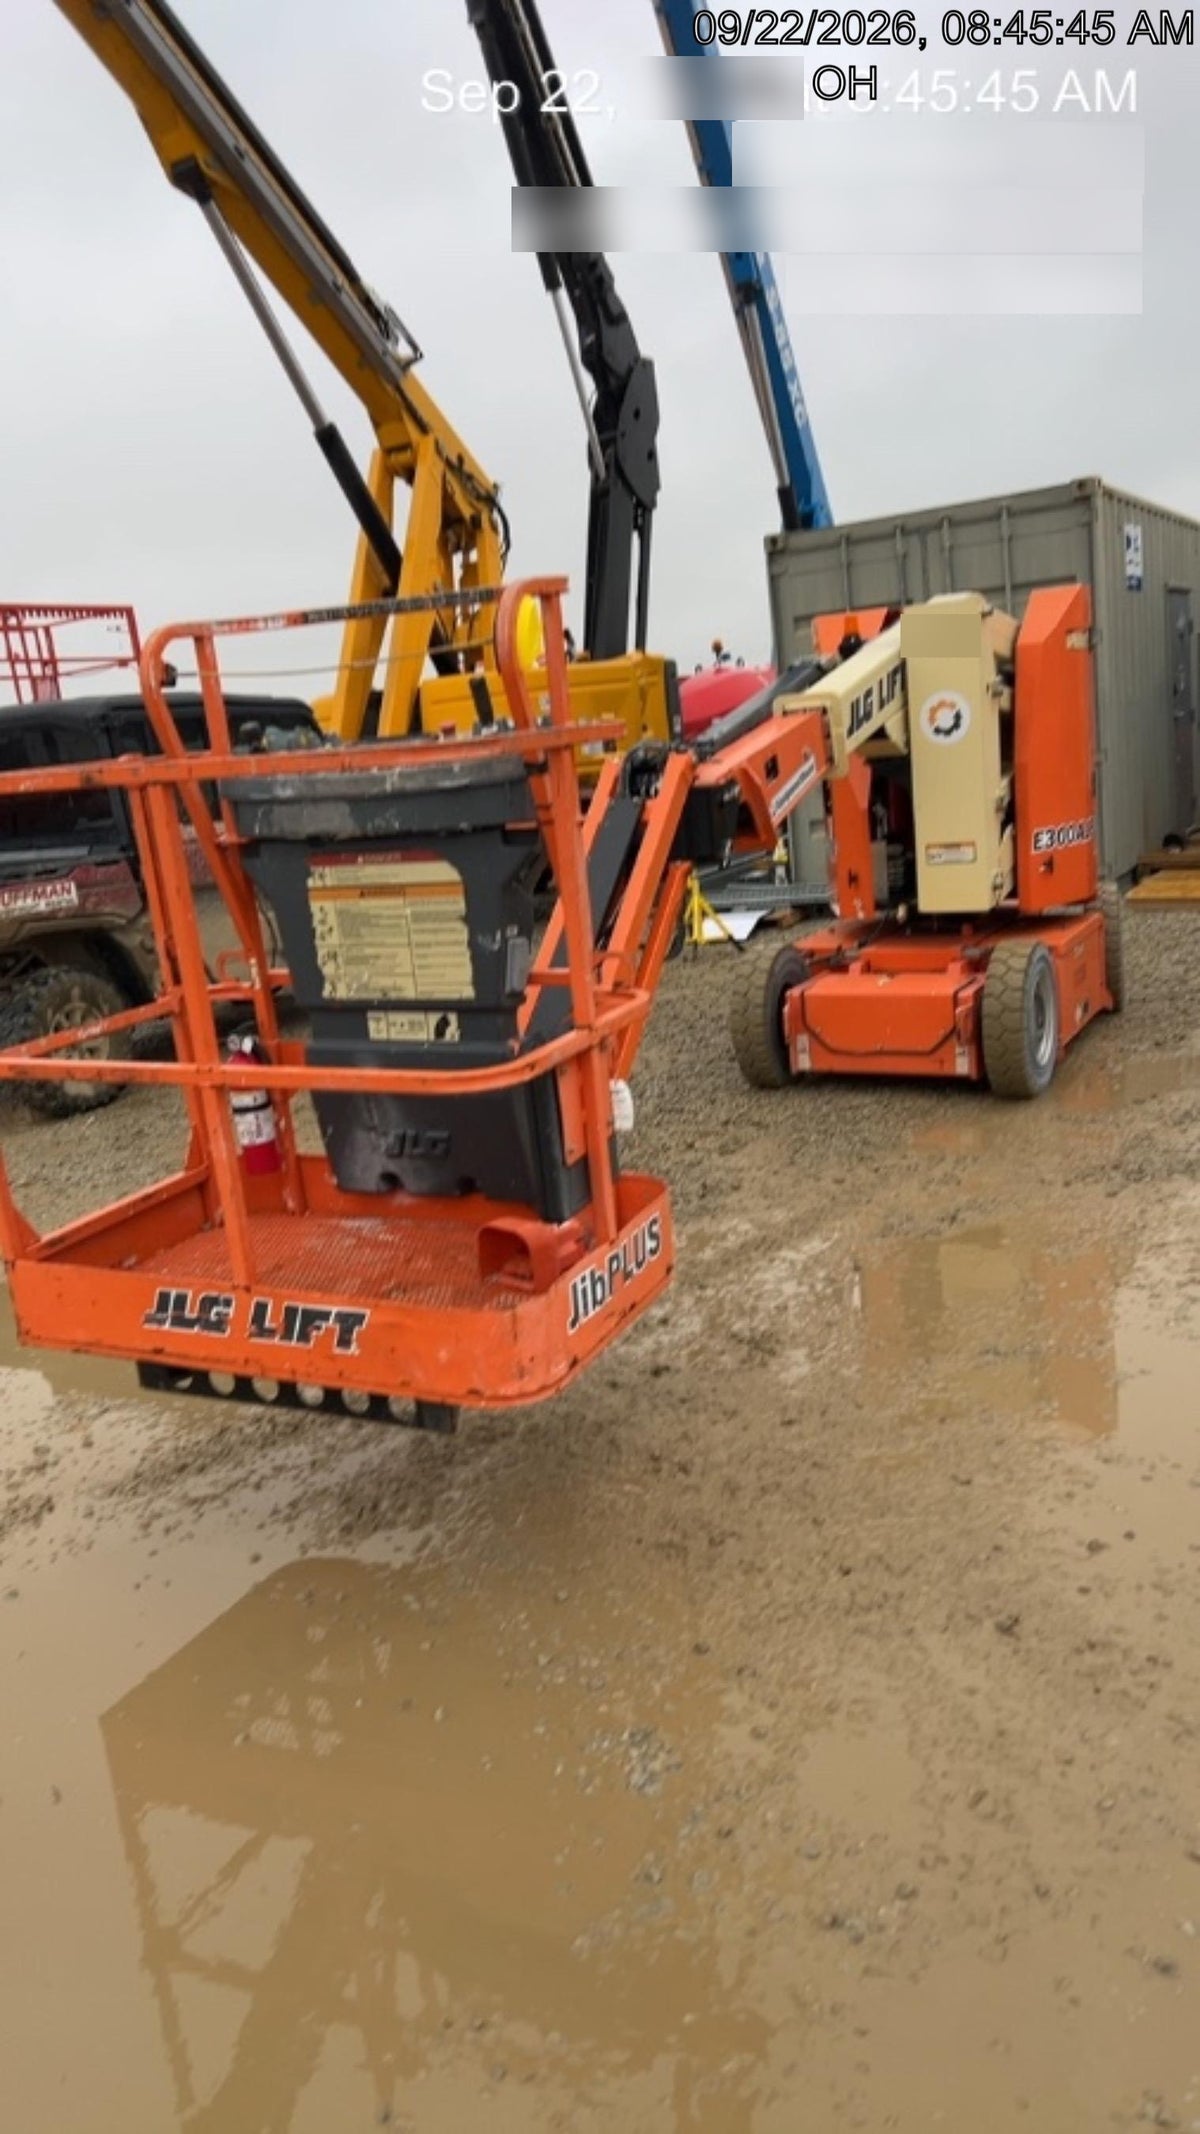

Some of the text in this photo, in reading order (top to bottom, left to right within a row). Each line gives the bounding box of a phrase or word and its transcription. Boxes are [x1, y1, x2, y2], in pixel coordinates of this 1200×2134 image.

[846, 685, 874, 739] JLG
[568, 1214, 661, 1333] JibPLUS
[143, 1288, 370, 1354] JLG LIFT
